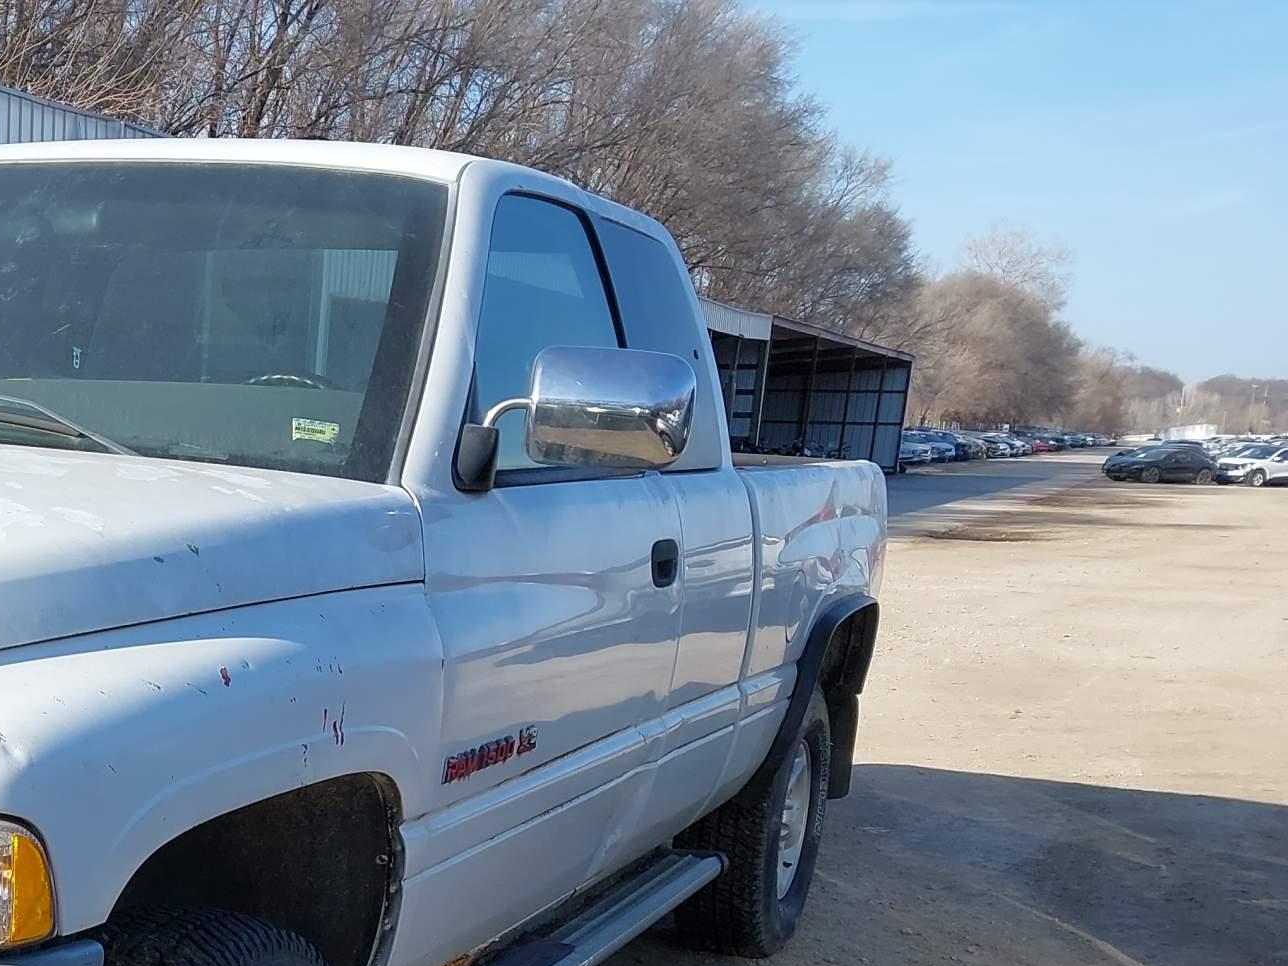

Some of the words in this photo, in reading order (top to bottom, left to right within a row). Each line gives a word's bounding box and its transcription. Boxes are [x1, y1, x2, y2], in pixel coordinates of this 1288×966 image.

[294, 425, 326, 436] MISSOURI
[444, 748, 478, 783] RAM
[477, 735, 516, 772] 1500
